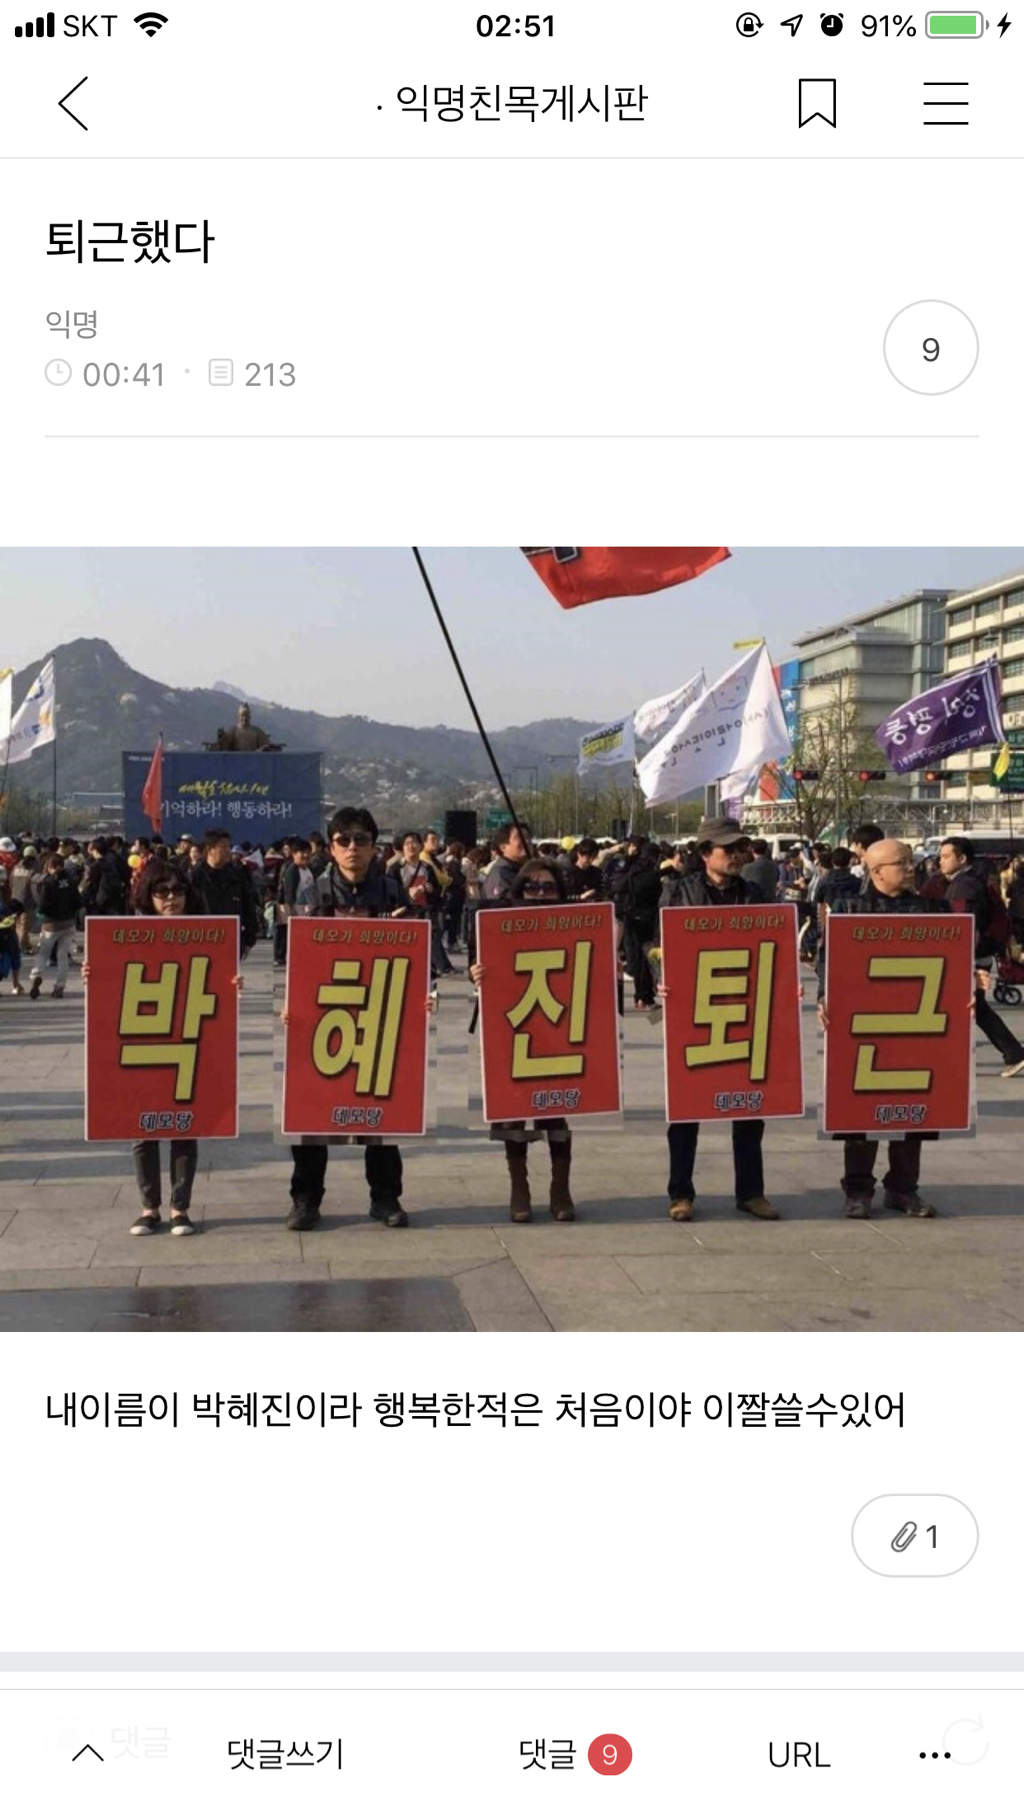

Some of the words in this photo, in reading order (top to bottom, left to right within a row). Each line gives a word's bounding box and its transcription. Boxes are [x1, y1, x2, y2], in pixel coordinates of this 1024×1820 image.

[62, 14, 118, 38] SKT
[475, 14, 554, 38] 02:51
[860, 14, 917, 38] 91%
[396, 84, 649, 123] 익명친목게시판
[45, 218, 216, 265] 퇴근했다
[45, 309, 98, 340] 익명
[922, 337, 941, 363] 9
[83, 362, 165, 388] 00:41
[245, 362, 297, 388] 213
[227, 801, 293, 819] 행동하라!
[113, 929, 155, 943] 데모가
[163, 928, 225, 943] 희망이다!
[502, 919, 538, 932] 데모가
[546, 915, 602, 930] 희망이다!
[684, 918, 722, 931] 데모가
[729, 915, 785, 930] 희망이다!
[852, 926, 893, 940] 데모가
[901, 926, 961, 940] 희망이다!
[313, 929, 352, 943] 데모가
[359, 930, 417, 944] 희망이다!
[506, 941, 592, 1080] 진
[685, 941, 775, 1081] 퇴
[119, 956, 216, 1101] 박
[312, 957, 409, 1098] 혜
[850, 957, 946, 1092] 근
[531, 1089, 580, 1108] 데모당
[712, 1091, 764, 1112] 데모당
[139, 1111, 194, 1130] 데모당
[331, 1107, 383, 1127] 데모당
[873, 1104, 927, 1124] 데모당
[46, 1391, 178, 1429] 내이름이
[193, 1391, 363, 1429] 박혜진이라
[372, 1391, 544, 1429] 행복한적은
[555, 1391, 692, 1429] 처음이야
[703, 1391, 906, 1429] 이짤쓸수있어
[926, 1524, 937, 1549] 1
[111, 1725, 172, 1760] 댓글
[227, 1737, 343, 1771] 댓글쓰기
[519, 1737, 577, 1771] 댓글
[602, 1743, 618, 1766] 9
[768, 1741, 832, 1769] URL
